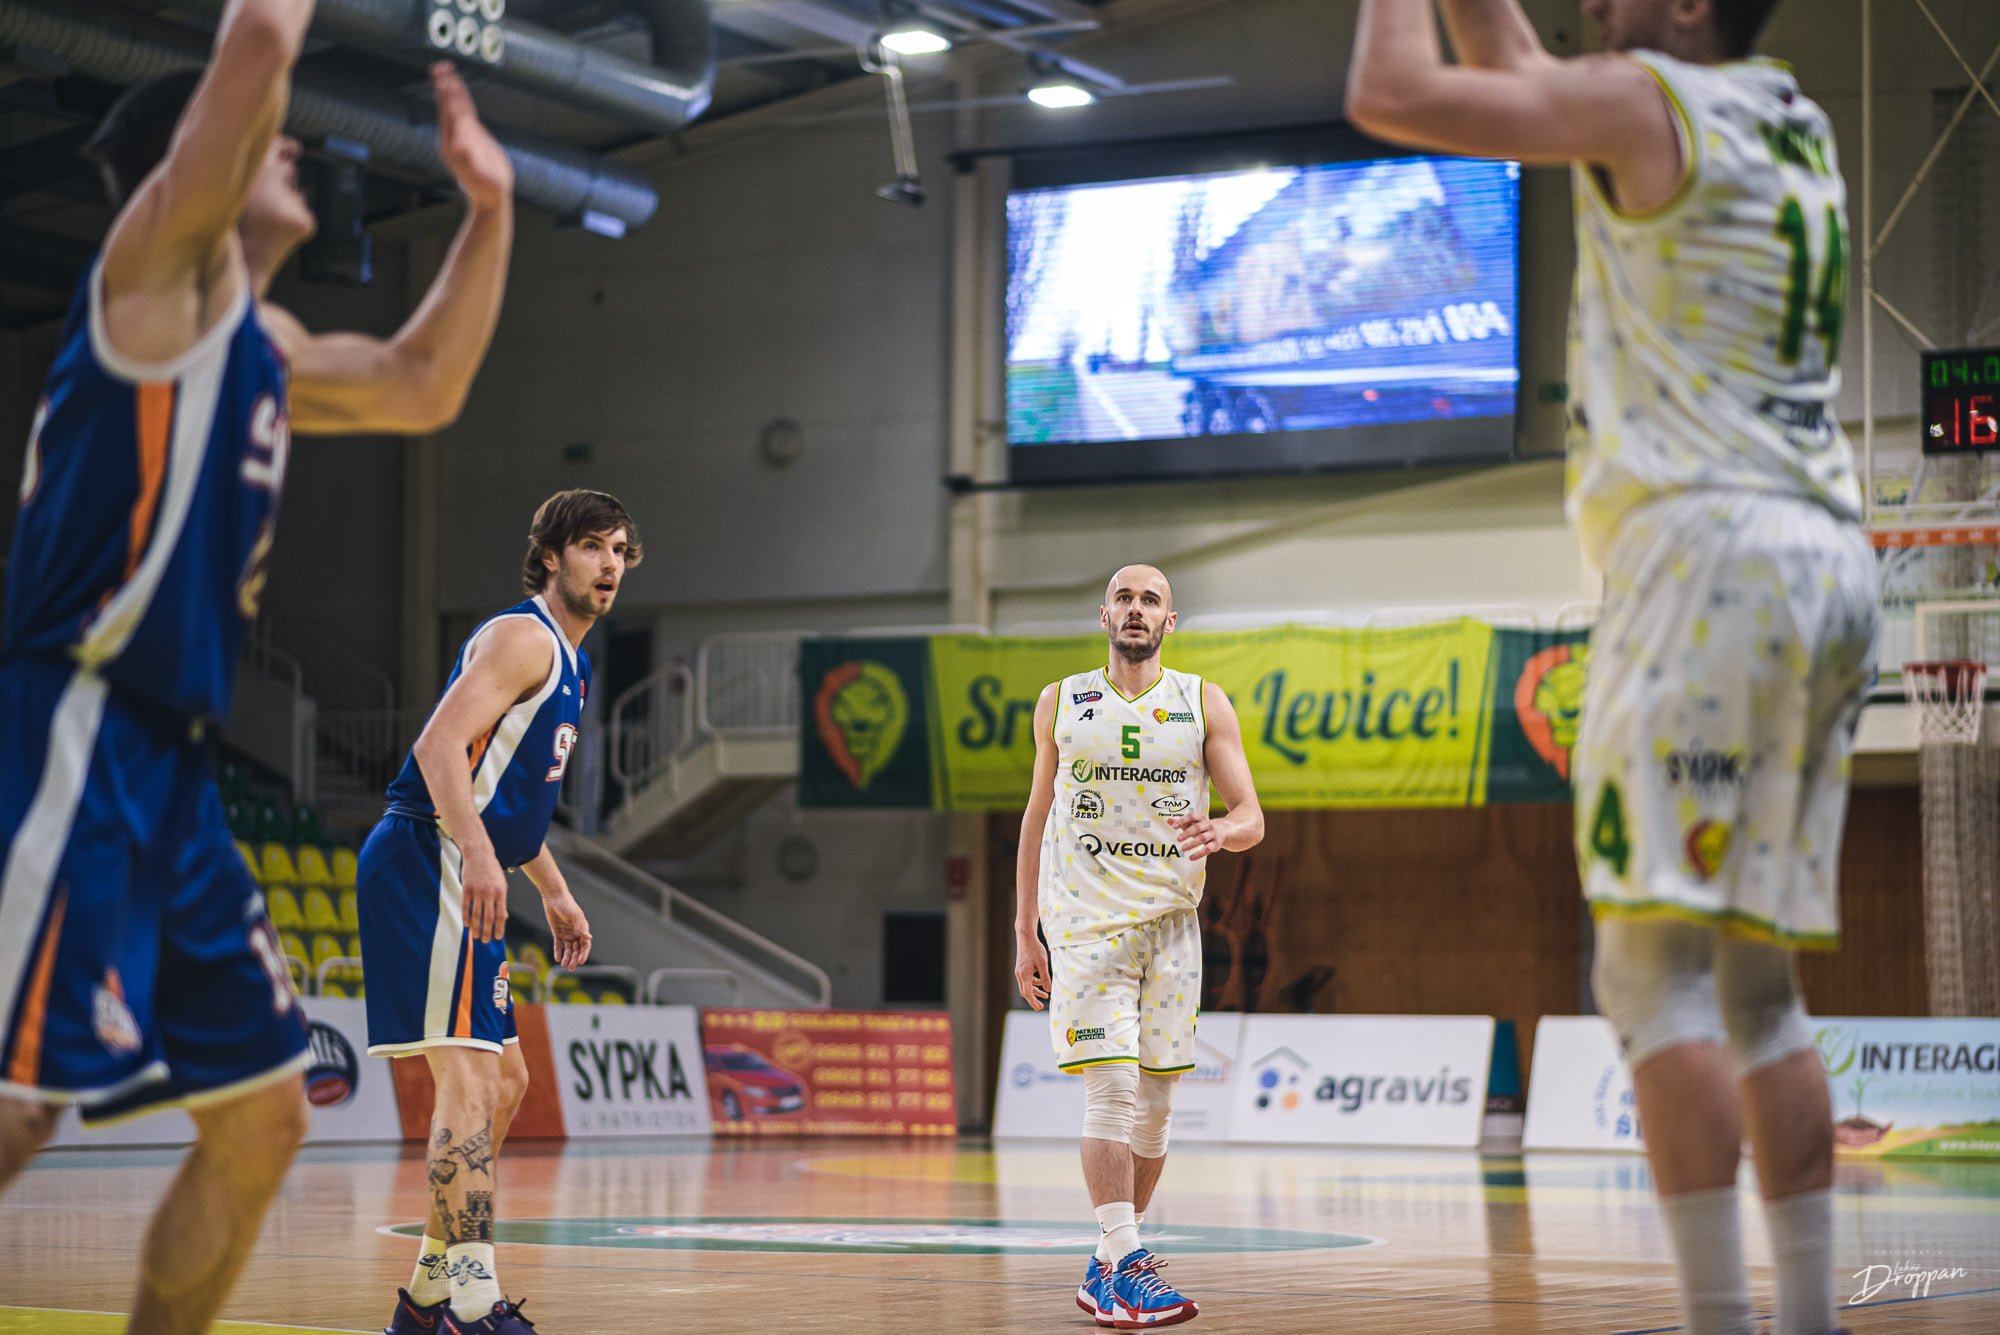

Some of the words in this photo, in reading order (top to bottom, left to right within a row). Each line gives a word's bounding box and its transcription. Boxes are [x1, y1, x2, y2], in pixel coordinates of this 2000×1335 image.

[1254, 657, 1460, 766] Levice!
[1121, 725, 1141, 759] 5
[1094, 766, 1187, 783] INTERAGROS
[1106, 842, 1181, 858] VEOLIA
[1861, 1042, 2000, 1072] INTERAG
[1314, 1065, 1472, 1112] agravis
